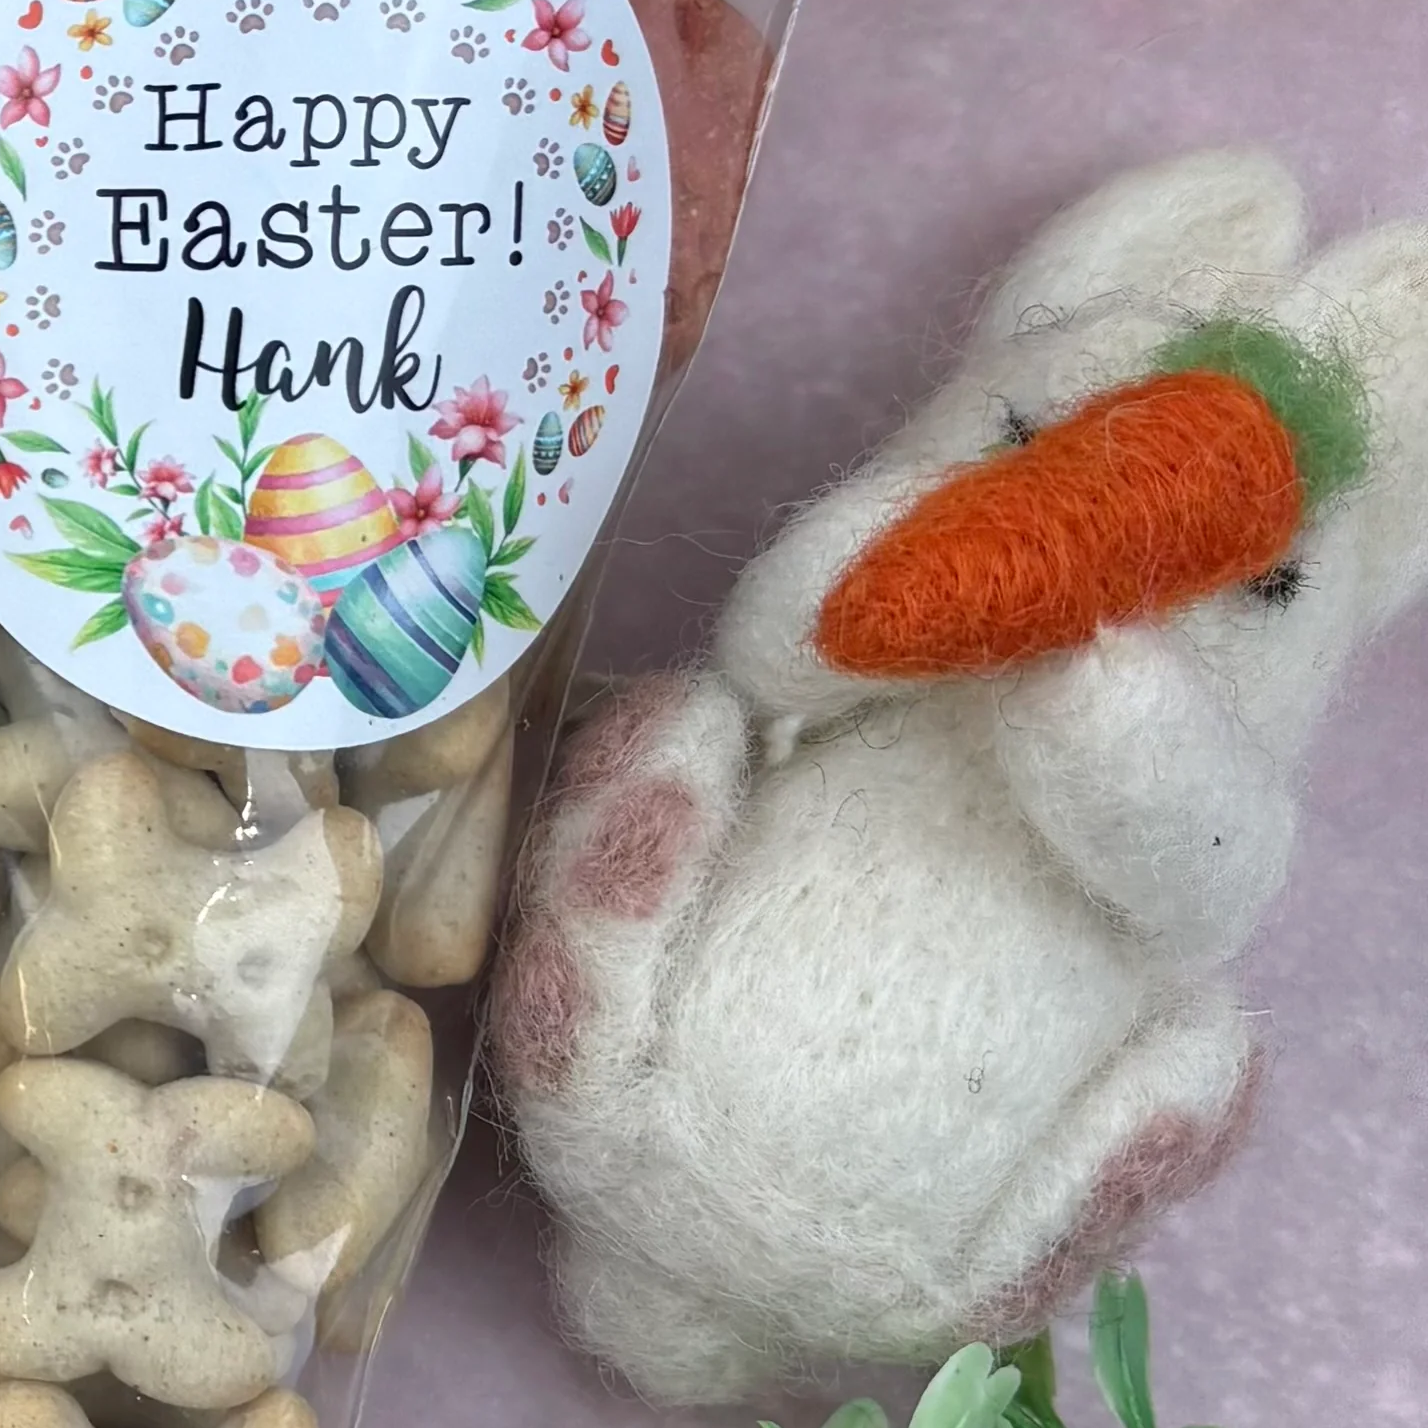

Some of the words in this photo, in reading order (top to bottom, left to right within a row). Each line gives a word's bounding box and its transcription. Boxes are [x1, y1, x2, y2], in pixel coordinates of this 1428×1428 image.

[144, 82, 470, 169] Happy
[95, 181, 522, 272] Easter!
[179, 285, 441, 413] Hank
